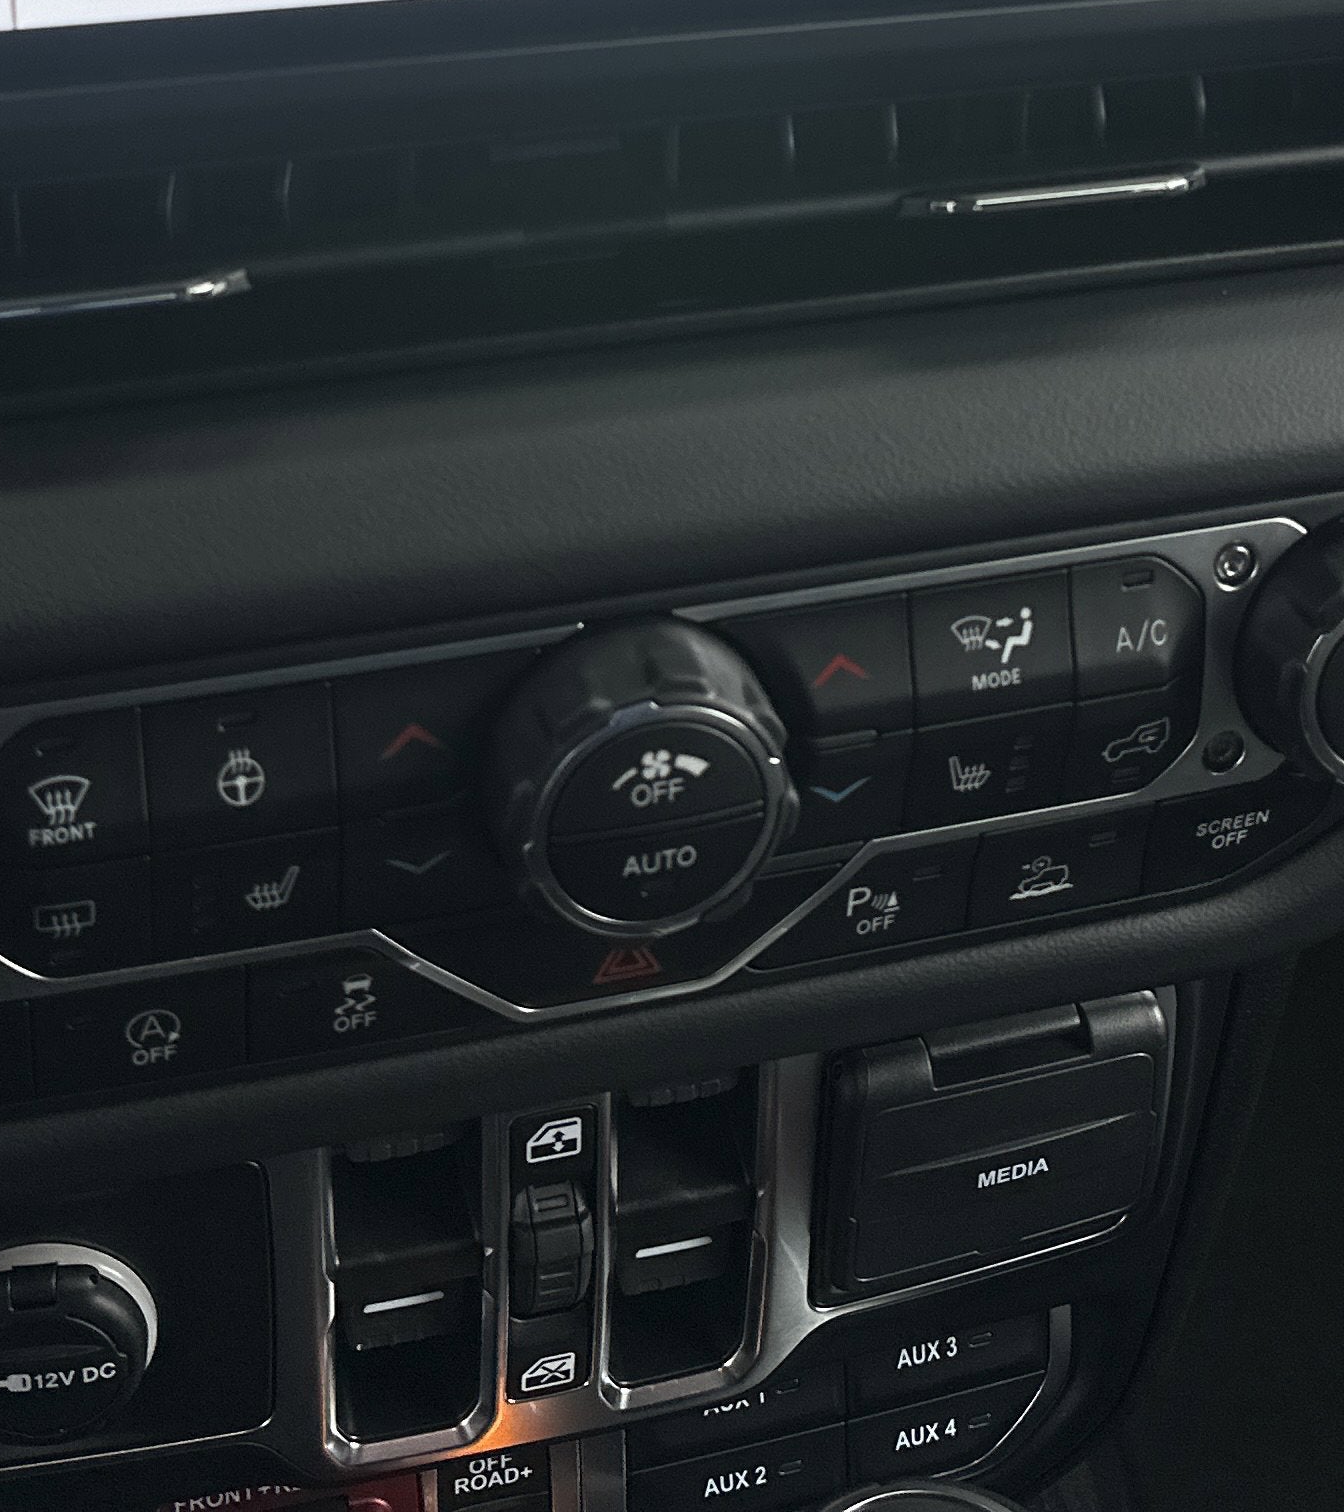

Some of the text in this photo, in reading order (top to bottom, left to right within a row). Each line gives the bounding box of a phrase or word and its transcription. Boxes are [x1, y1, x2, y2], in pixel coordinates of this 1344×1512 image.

[1115, 617, 1170, 653] A/C
[970, 666, 1022, 692] MODE
[629, 777, 687, 808] OFF
[28, 821, 98, 847] FRONT
[1194, 808, 1271, 838] SCREEN
[1210, 827, 1249, 850] OFF
[621, 845, 698, 878] AUTO
[856, 913, 896, 936] OFF
[333, 1010, 377, 1033] OFF
[131, 1045, 178, 1066] OFF
[977, 1157, 1049, 1189] MEDIA
[896, 1336, 958, 1370] AUX 3
[33, 1362, 117, 1390] 12V DC
[894, 1418, 958, 1451] AUX 4
[454, 1466, 534, 1495] ROAD+
[703, 1465, 768, 1498] AUX 2
